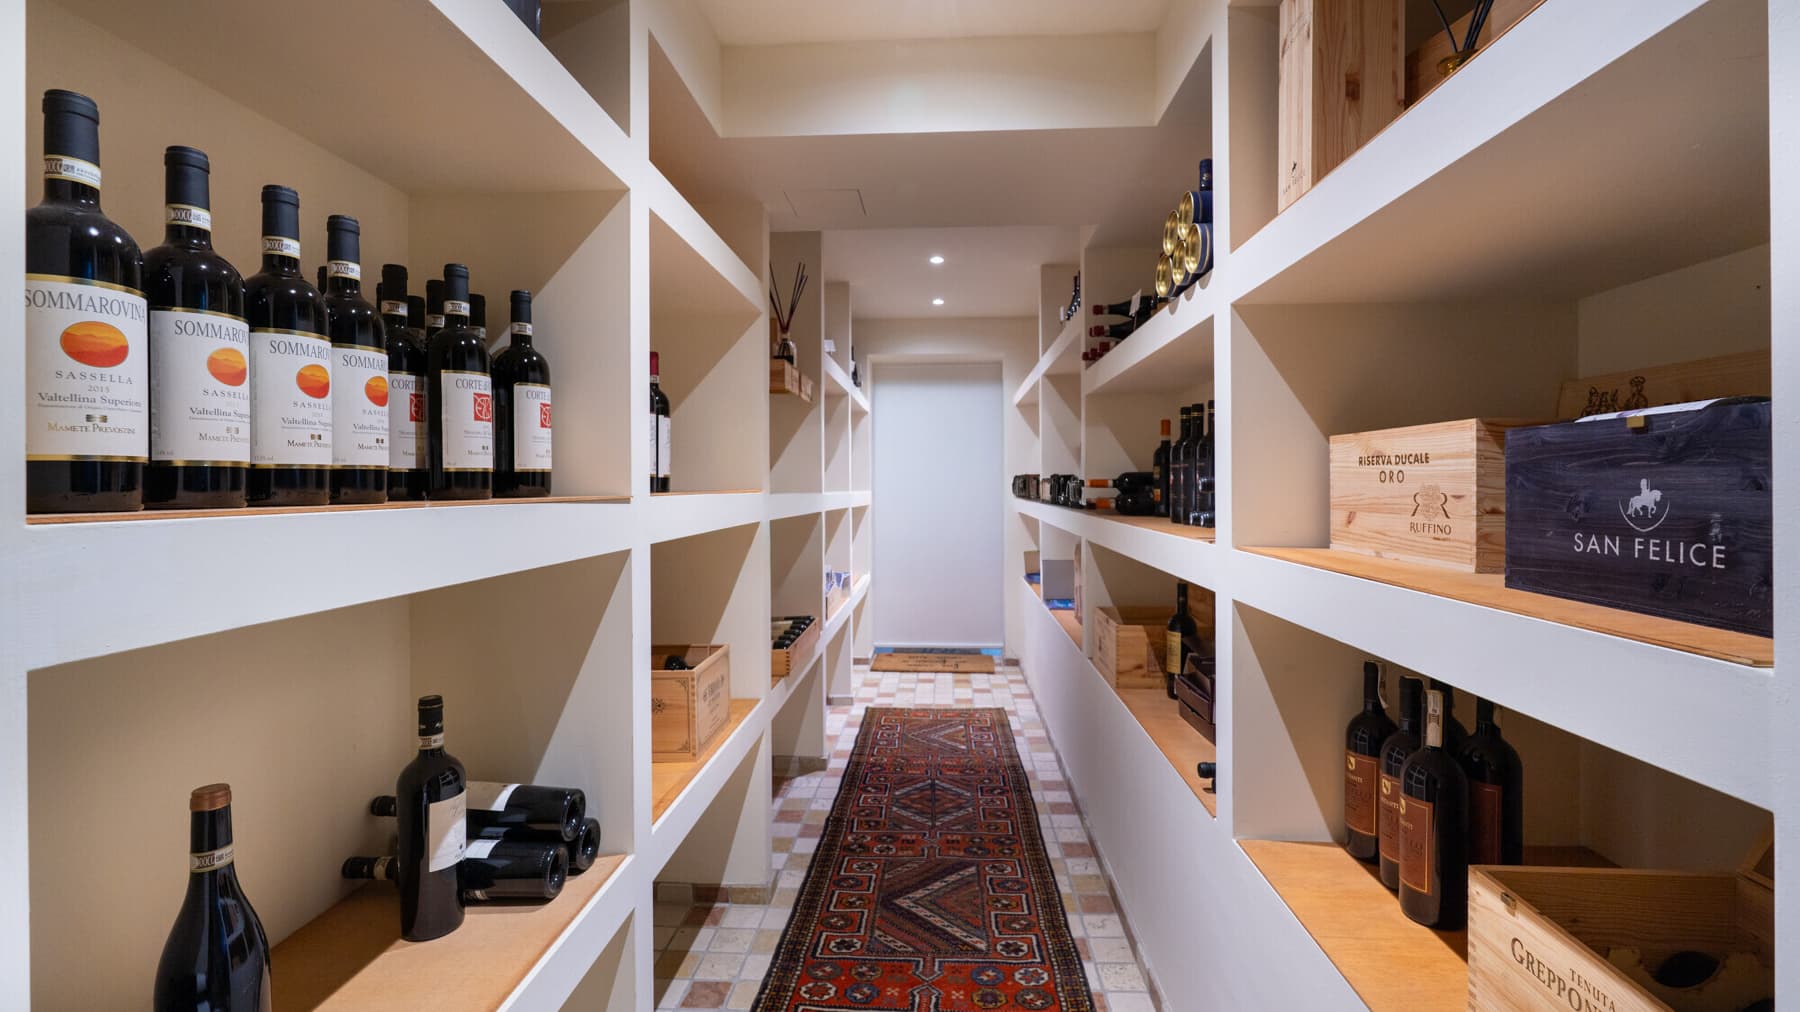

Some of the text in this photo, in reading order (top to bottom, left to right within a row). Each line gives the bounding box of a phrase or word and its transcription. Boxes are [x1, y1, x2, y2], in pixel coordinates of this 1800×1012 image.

[55, 370, 133, 384] SASSELLA
[37, 392, 97, 404] Valtellina
[1358, 452, 1430, 467] RISERVA DUCALE
[1379, 469, 1405, 484] ORO
[1409, 521, 1452, 536] RUFFINO
[1574, 532, 1726, 569] SAN FELICE
[1510, 936, 1602, 1012] GREPPON
[1569, 968, 1616, 1012] TENUTA
